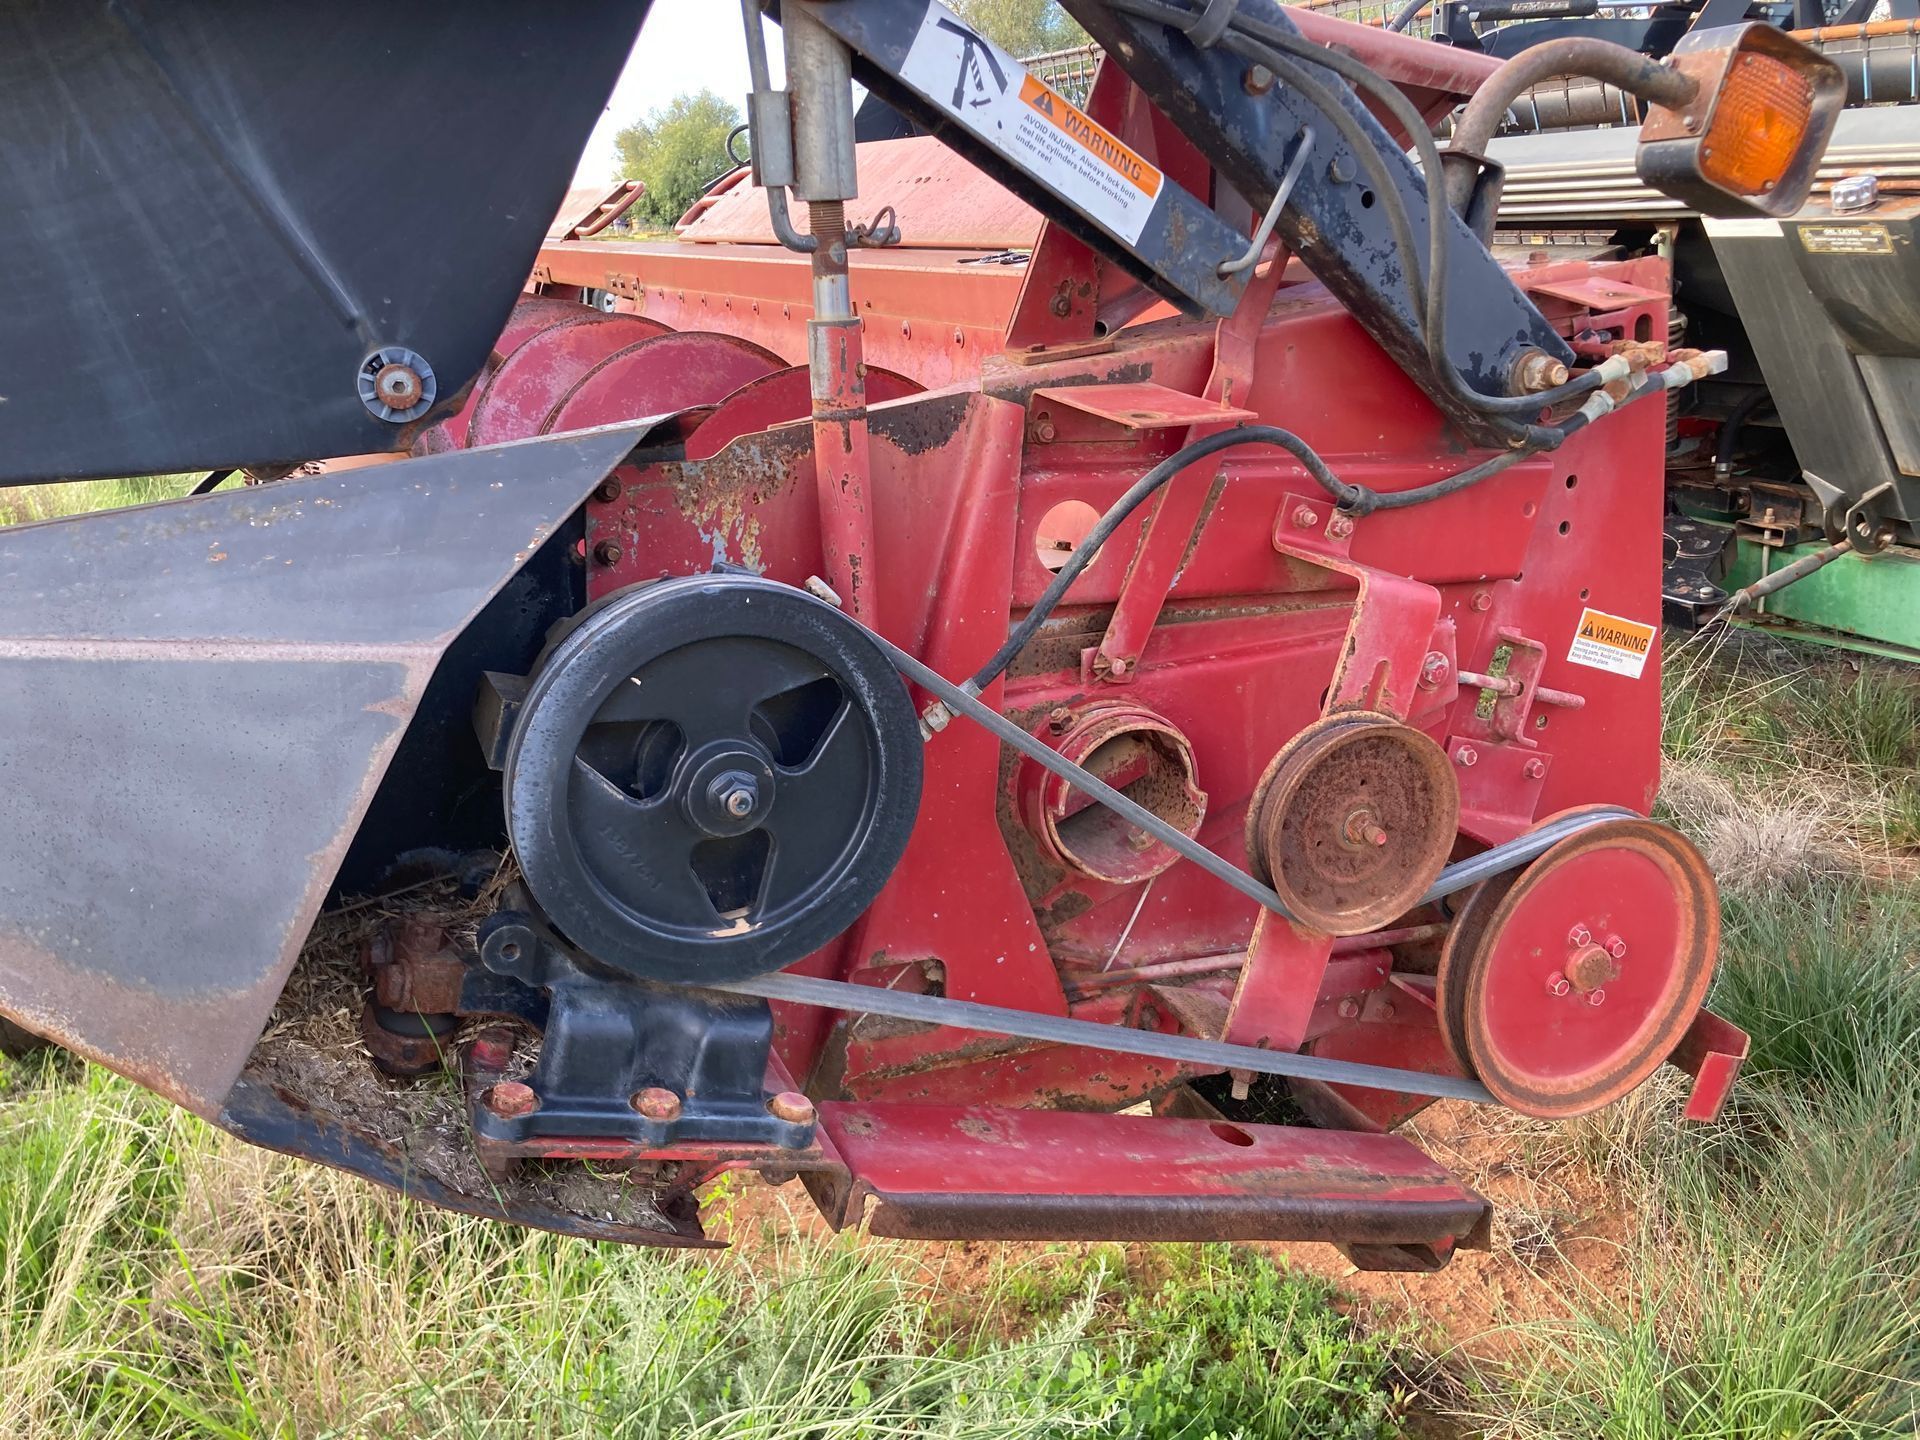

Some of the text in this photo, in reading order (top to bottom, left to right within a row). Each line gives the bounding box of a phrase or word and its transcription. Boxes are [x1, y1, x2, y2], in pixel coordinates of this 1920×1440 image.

[1015, 134, 1052, 165] under reel.
[1019, 124, 1129, 209] reel lift cylinders before working
[1024, 113, 1048, 133] AVOID
[1080, 155, 1104, 178] Always
[1106, 174, 1119, 189] lock
[1120, 185, 1136, 200] both
[1065, 110, 1142, 181] WARNING
[1596, 625, 1648, 652] WARNING
